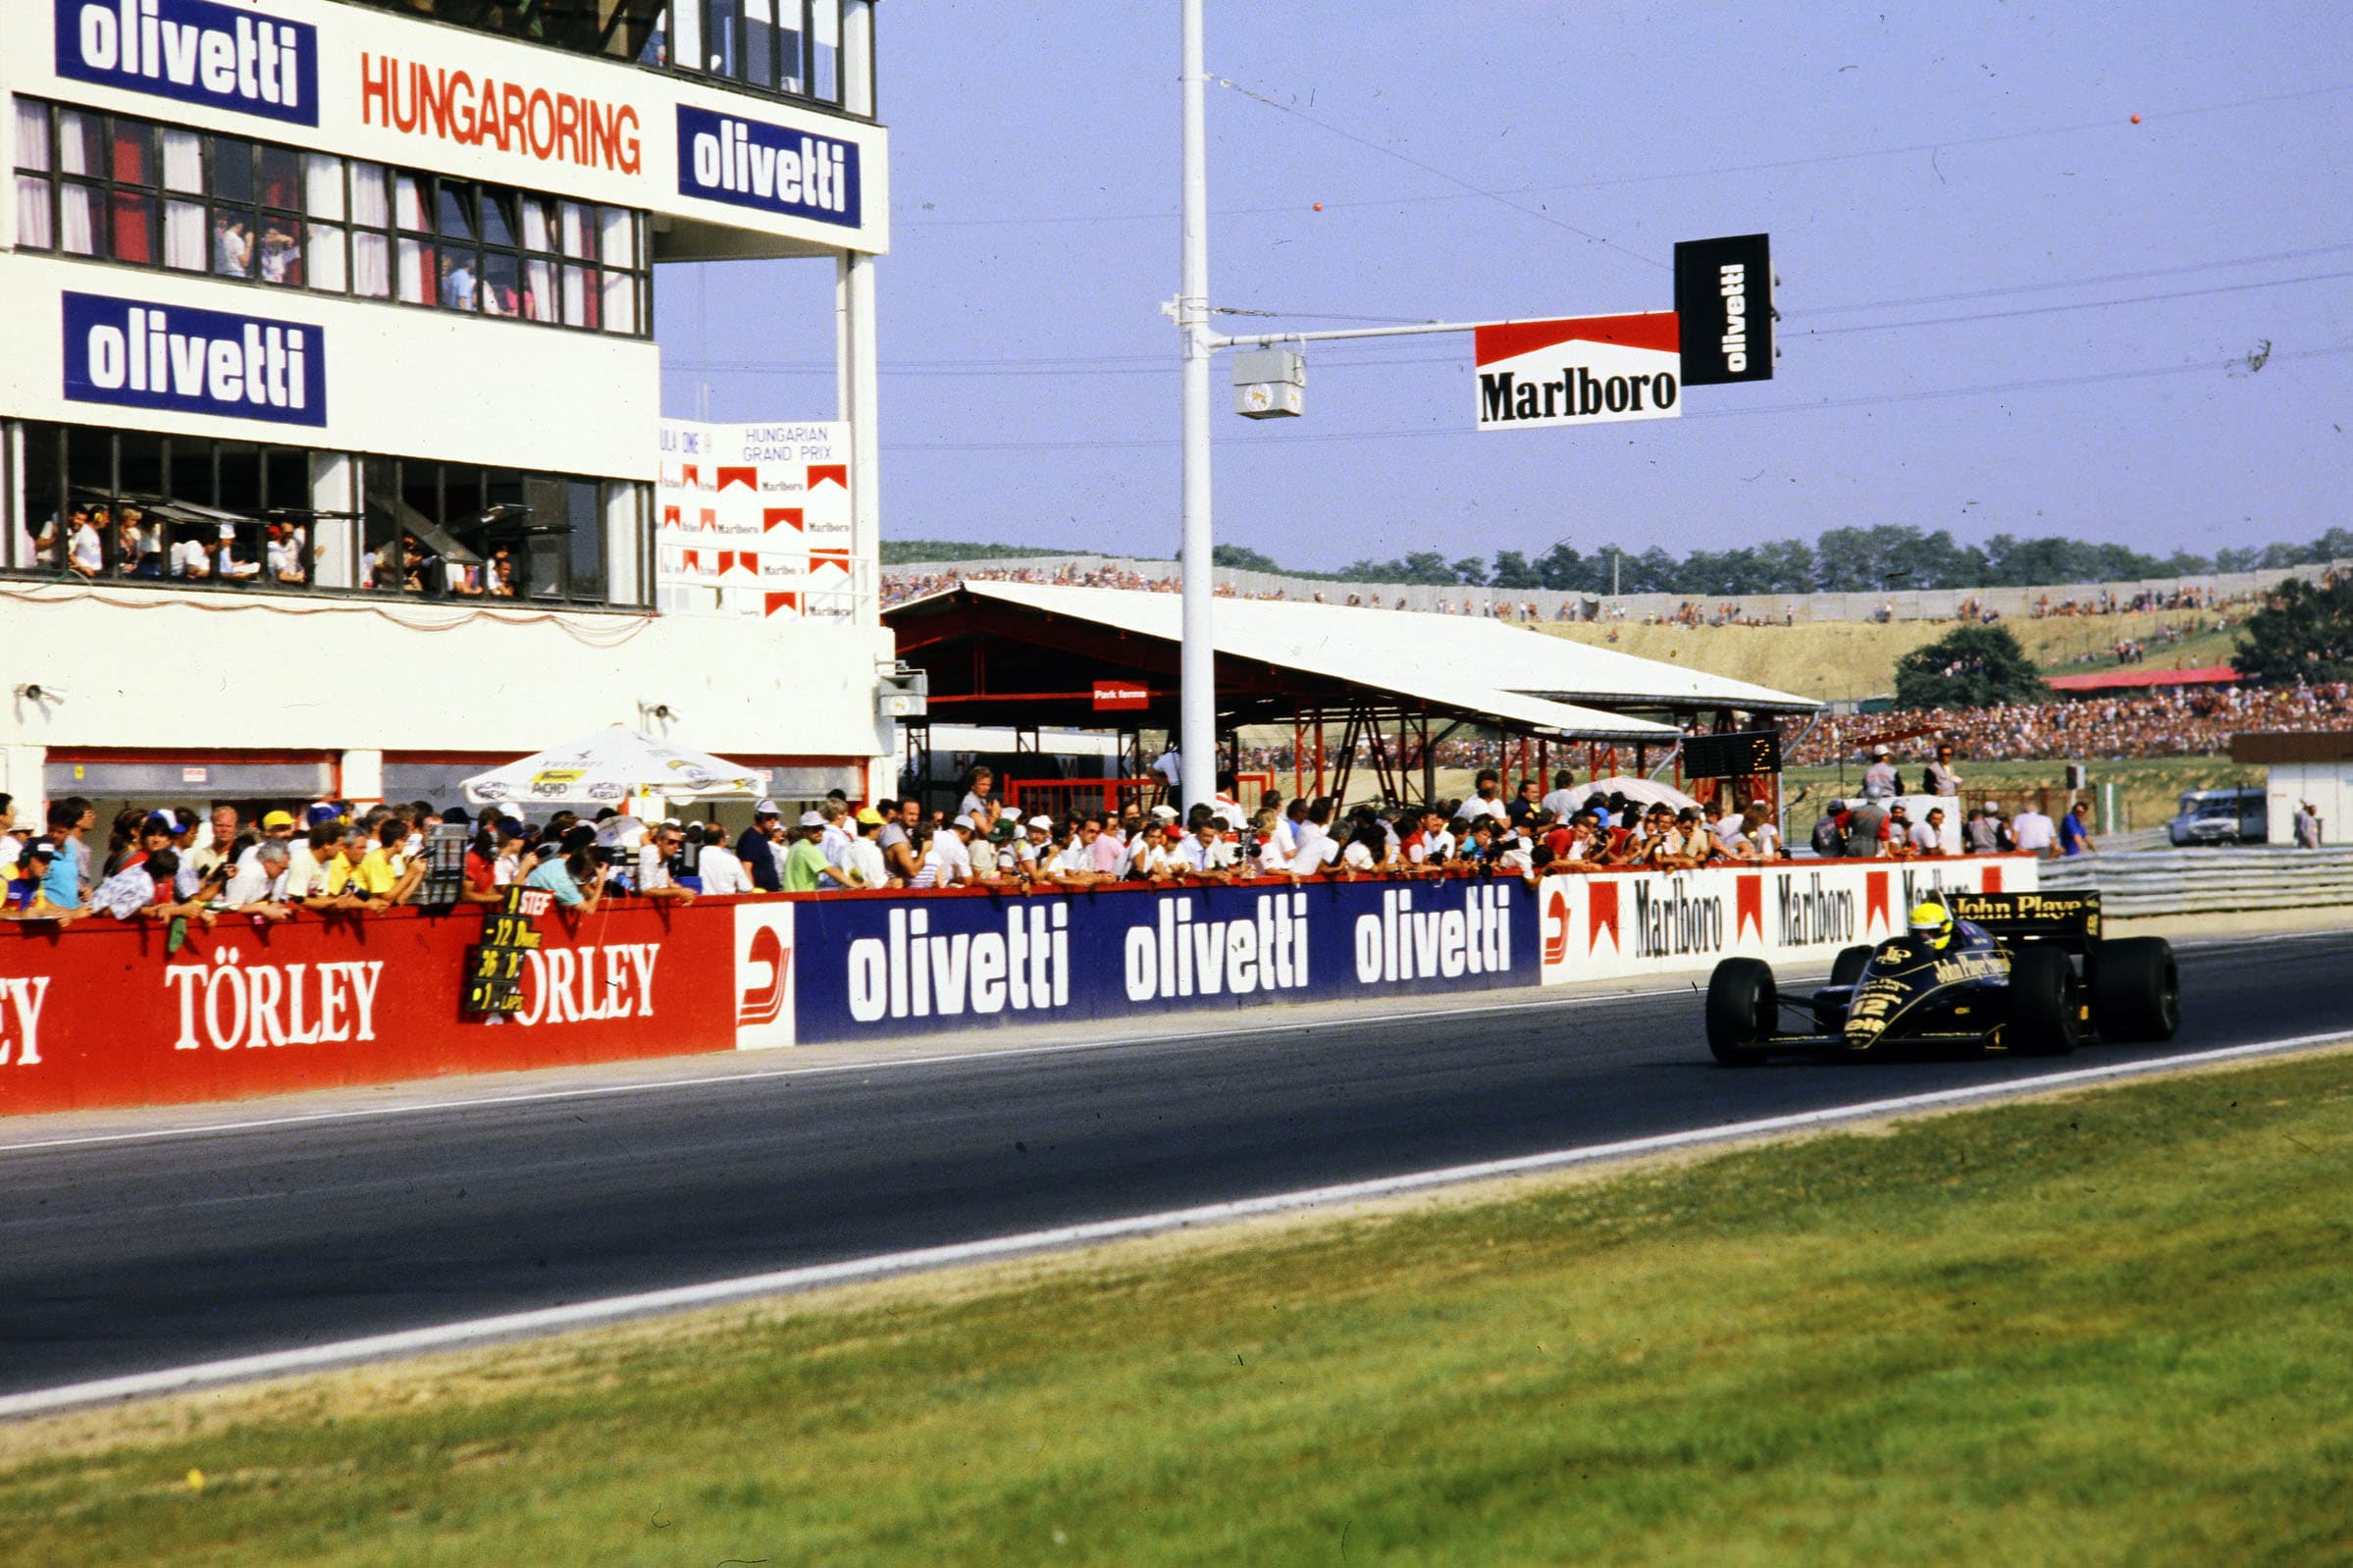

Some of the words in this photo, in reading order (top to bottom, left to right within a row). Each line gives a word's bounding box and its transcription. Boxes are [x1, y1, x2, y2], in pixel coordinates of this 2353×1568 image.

[79, 0, 297, 107] olivetti
[362, 53, 641, 175] HUNGARORING
[694, 119, 846, 212] olivetti
[87, 307, 305, 410] olivetti
[1720, 264, 1746, 373] olivetti
[746, 427, 828, 443] HUNGARIAN
[1480, 367, 1676, 424] Marlboro
[744, 446, 792, 461] GRAND
[801, 445, 832, 460] PRIX
[1094, 690, 1117, 700] Park
[532, 781, 568, 797] Agip
[1752, 739, 1771, 770] 2
[1124, 892, 1308, 1002] olivetti
[1355, 884, 1510, 984] olivetti
[1635, 878, 1723, 959] Marlboro
[1777, 870, 1855, 948] Marlboro
[1957, 897, 2012, 920] John
[165, 946, 384, 1050] TÖRLEY
[848, 902, 1069, 1022] olivetti
[1844, 1017, 1886, 1033] elf
